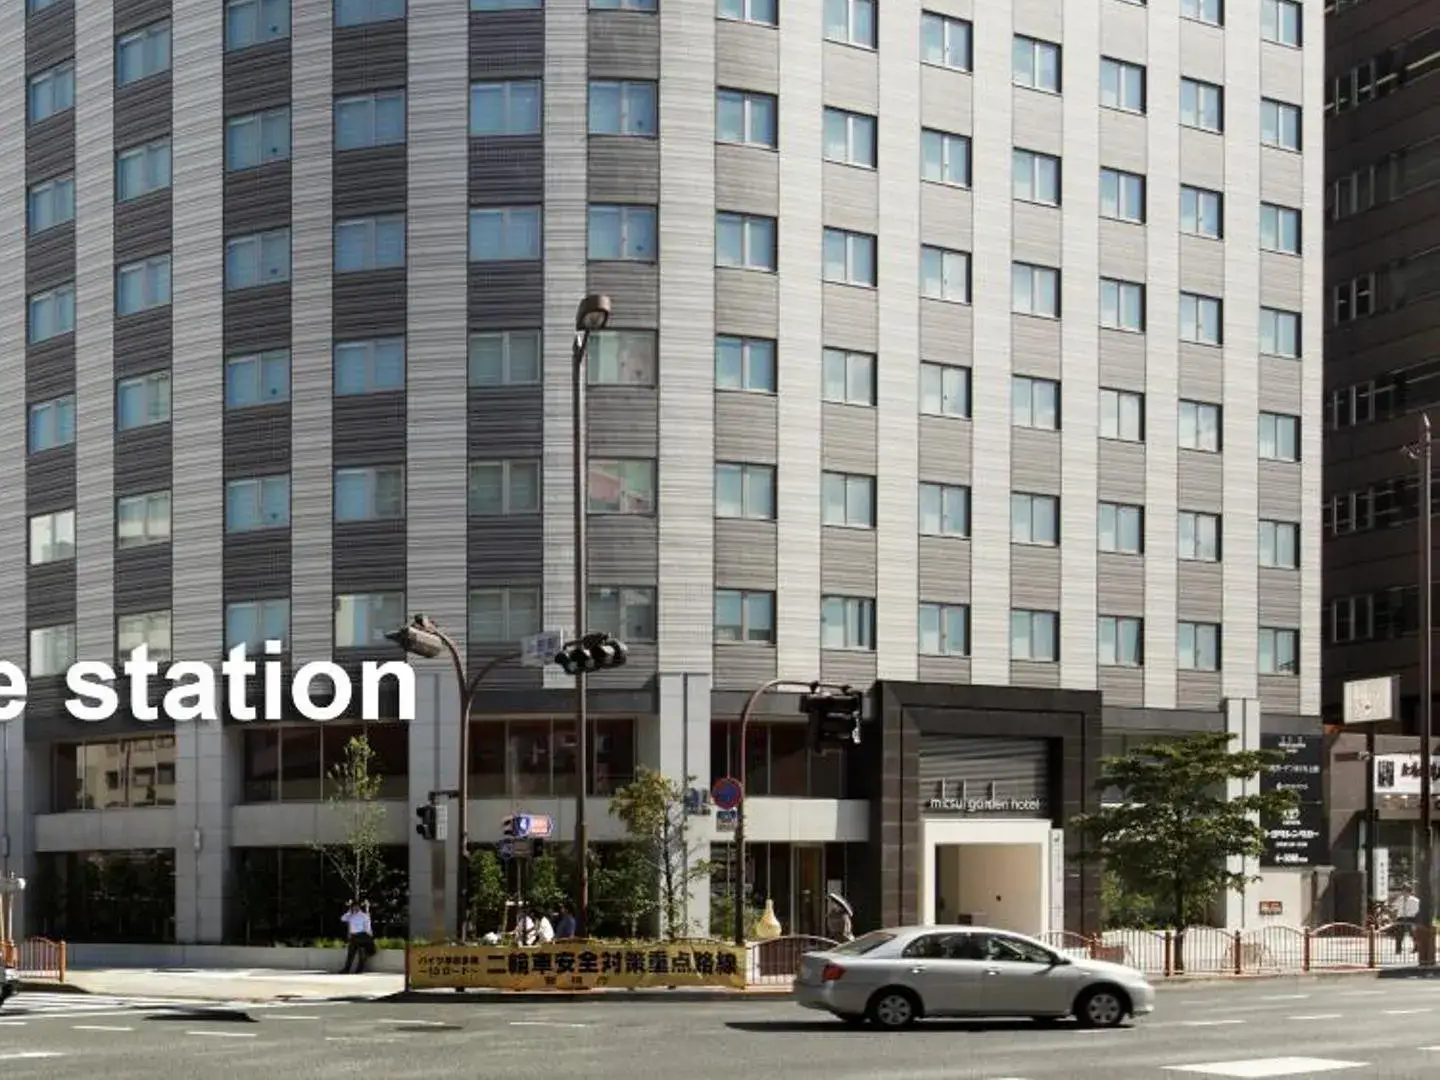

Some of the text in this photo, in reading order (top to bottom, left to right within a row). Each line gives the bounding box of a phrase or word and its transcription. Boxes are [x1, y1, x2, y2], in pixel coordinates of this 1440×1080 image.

[930, 778, 1041, 812] mitsui garden hotel
[486, 952, 738, 977] 二輪車安全対策重点路線
